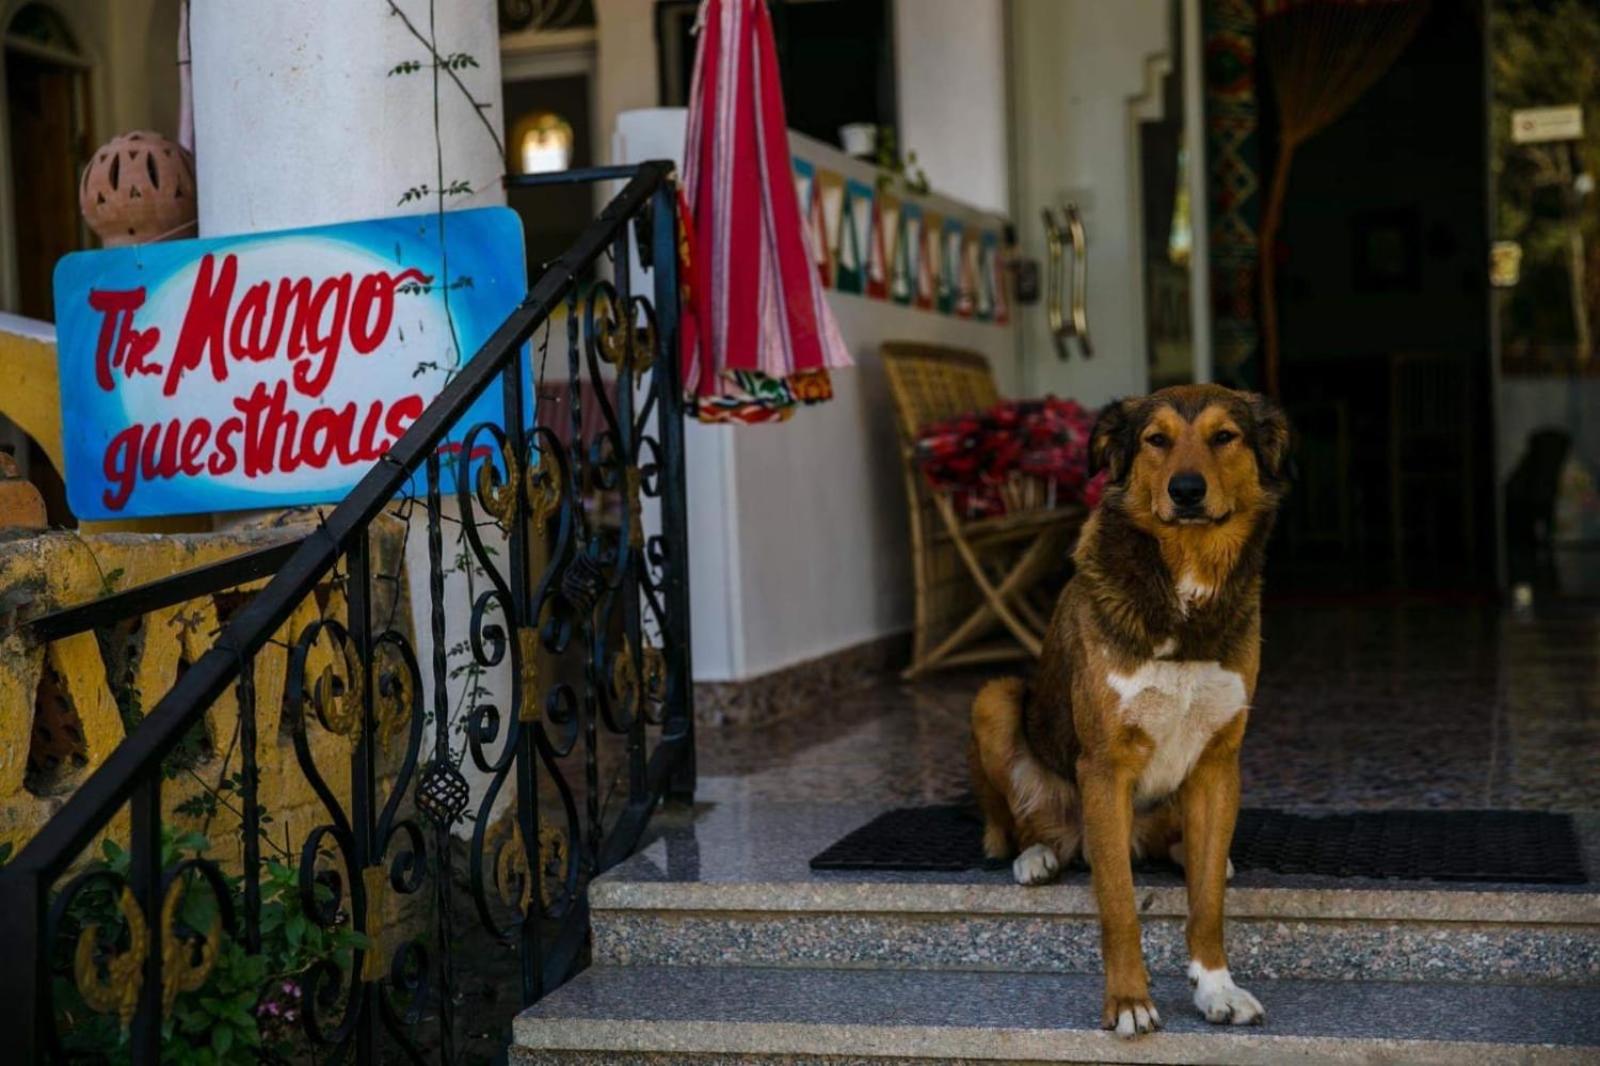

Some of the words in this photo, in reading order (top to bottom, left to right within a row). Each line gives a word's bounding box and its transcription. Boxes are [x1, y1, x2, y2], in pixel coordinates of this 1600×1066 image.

[88, 286, 163, 392] The
[162, 253, 434, 397] Mango
[103, 379, 492, 511] guesthous
